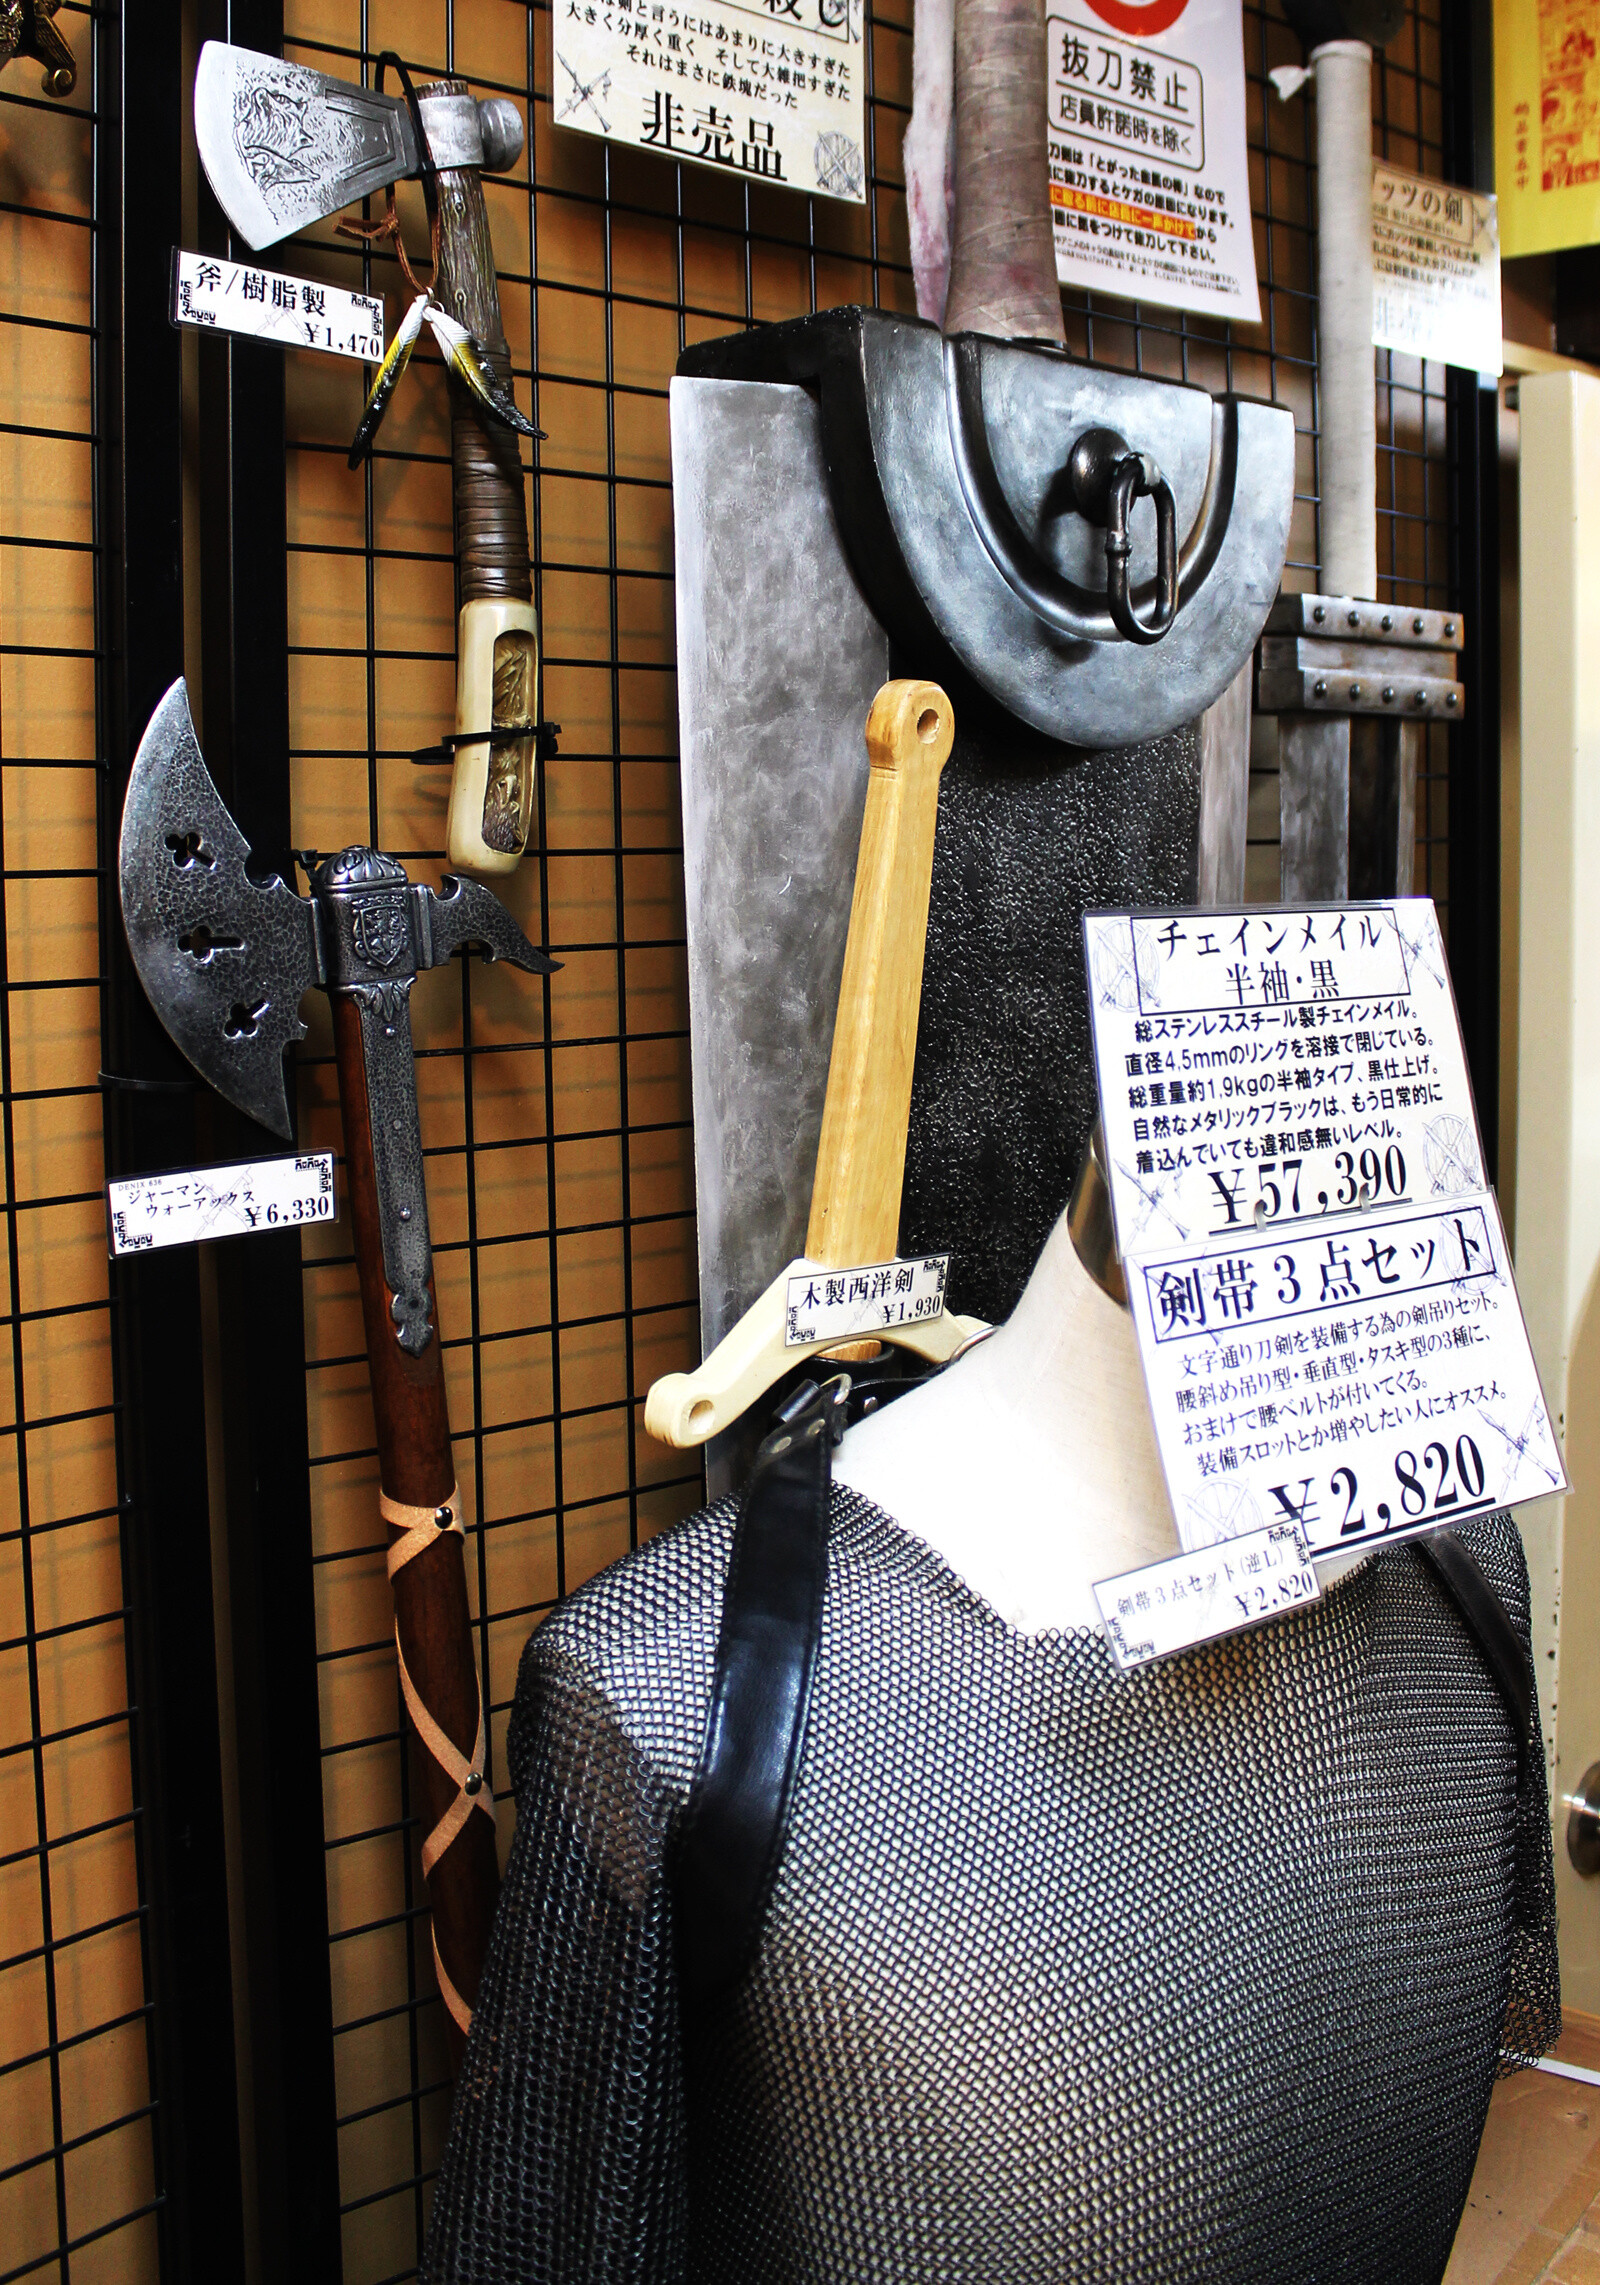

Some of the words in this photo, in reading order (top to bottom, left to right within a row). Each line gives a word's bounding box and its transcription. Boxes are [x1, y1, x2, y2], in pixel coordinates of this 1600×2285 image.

[627, 44, 798, 109] それはまさに鉄塊だった
[1062, 32, 1190, 114] 抜刀禁止
[641, 89, 783, 177] 非売品
[1060, 93, 1193, 155] 店員許諾時を除く
[195, 261, 326, 317] 斧/樹脂製
[303, 322, 380, 357] ¥1,470
[1157, 913, 1383, 961] チェインメイル
[1225, 958, 1340, 1006] 半袖・黒
[1134, 1000, 1418, 1044] 総ステンレススチール製チェインメイル。
[1132, 1081, 1443, 1142] 自然なメタリックブラックは、もう日常的に
[1135, 1118, 1403, 1175] 着込んでいても違和感無いレベル。
[118, 1182, 146, 1191] DENIX
[128, 1183, 206, 1205] ジャーマン
[145, 1191, 255, 1219] ウォーアックス
[244, 1196, 329, 1227] ¥6,330
[1208, 1144, 1407, 1225] ¥57,390
[800, 1267, 915, 1310] 木製西洋剣
[883, 1295, 940, 1324] ¥1,930
[1180, 1291, 1498, 1379] 文字通り刀剣を装備する為の剣吊りセット。
[1183, 1370, 1427, 1447] おまけで腰ベルトが付いてくる。
[1197, 1380, 1507, 1477] 装備スロットとか増やしたい人にオススメ。
[1268, 1434, 1486, 1547] ¥2,820
[1234, 1570, 1314, 1617] ¥2,820
